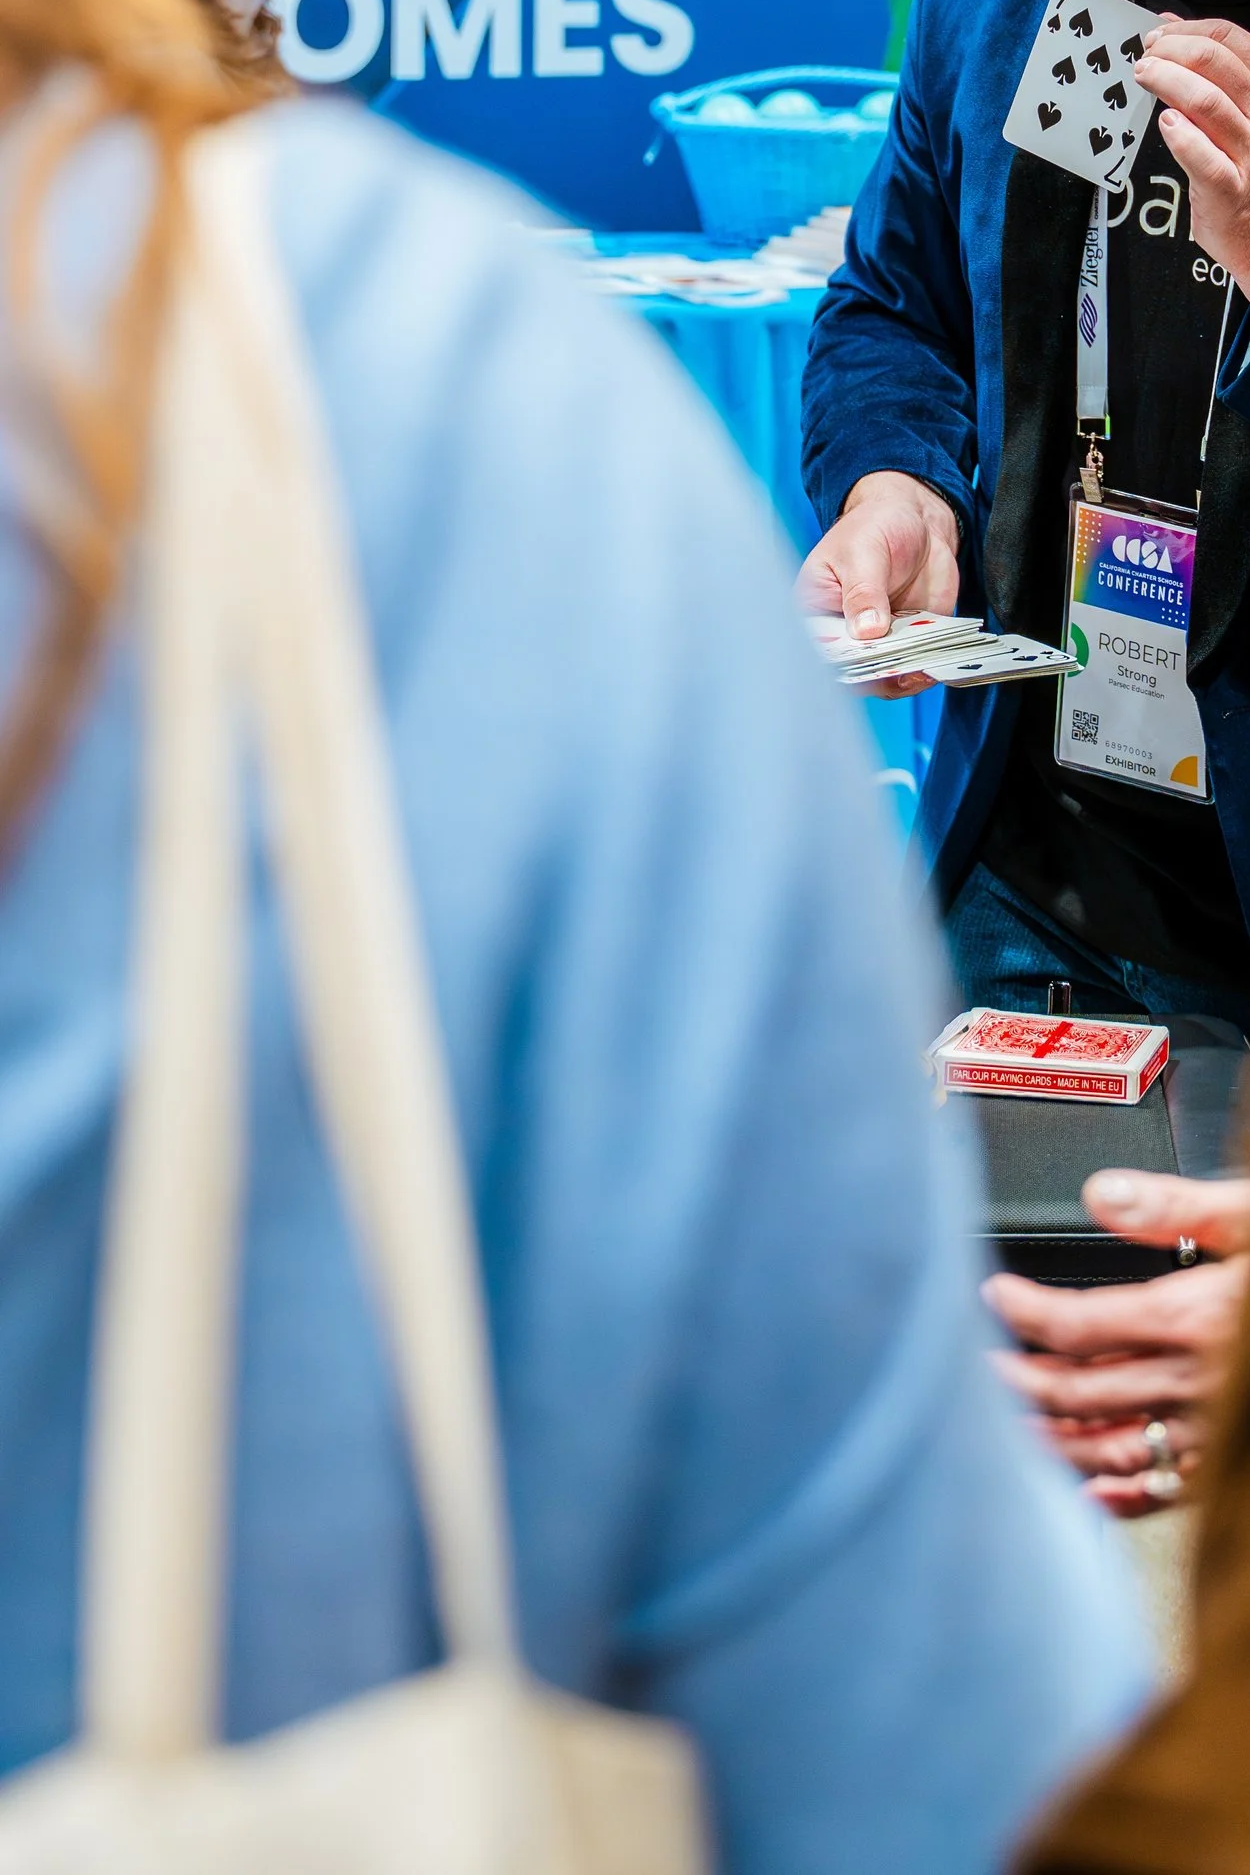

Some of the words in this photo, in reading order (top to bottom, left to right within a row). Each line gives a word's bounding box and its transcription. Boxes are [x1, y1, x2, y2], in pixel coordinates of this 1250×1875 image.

[1112, 535, 1173, 573] CCSA
[1099, 562, 1131, 575] CALIFORNIA
[1131, 570, 1157, 581] CHARTER
[1157, 576, 1184, 588] SCHOOLS
[1098, 570, 1183, 606] CONFERENCE
[1098, 632, 1181, 670] ROBERT
[1117, 665, 1157, 688] Strong
[1108, 678, 1130, 690] Parsec
[1131, 684, 1165, 700] Education
[1105, 740, 1153, 760] 68970003
[1105, 754, 1157, 777] EXHIBITOR
[952, 1069, 989, 1081] PARLOUR
[991, 1072, 1024, 1084] PLAYING
[1025, 1075, 1052, 1086] CARDS
[1057, 1077, 1080, 1089] MADE
[1081, 1079, 1090, 1089] IN
[1091, 1080, 1107, 1090] THE
[1108, 1081, 1120, 1092] EU
